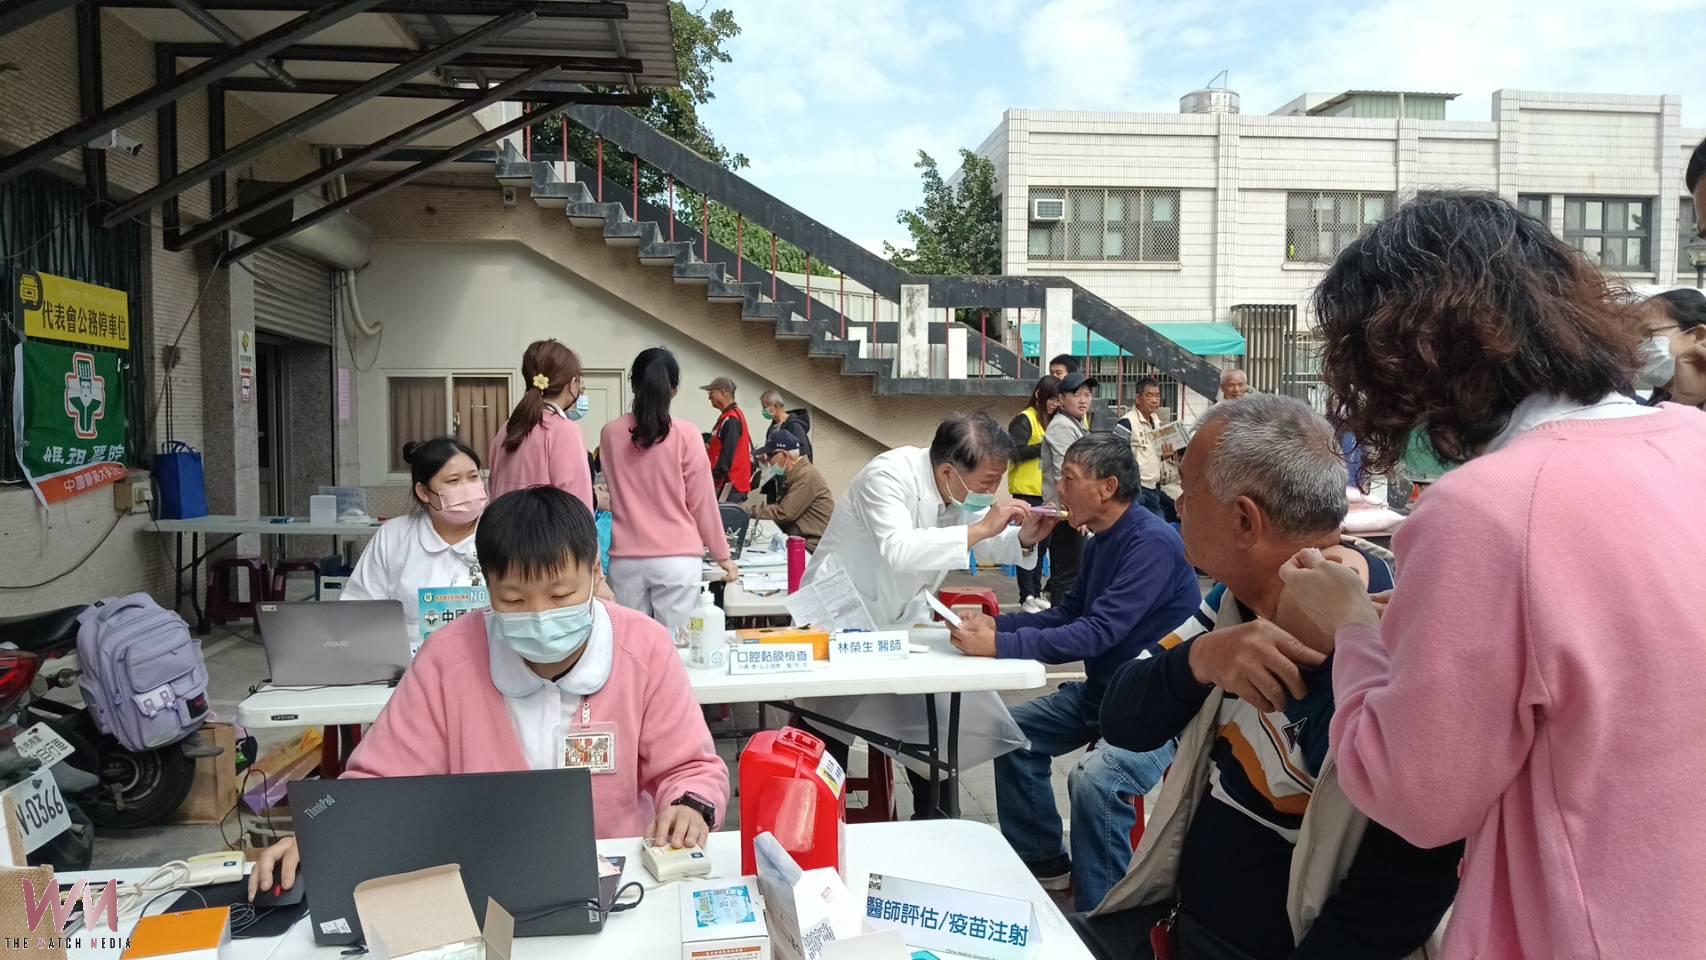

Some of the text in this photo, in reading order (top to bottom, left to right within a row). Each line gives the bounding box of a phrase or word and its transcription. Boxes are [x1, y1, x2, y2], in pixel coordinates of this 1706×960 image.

[42, 300, 127, 341] 代表會公務停車位
[737, 650, 808, 663] 口腔黏膜檢查
[838, 639, 902, 654] 林榮生 醫師
[303, 793, 336, 819] ThinkPad
[866, 895, 1029, 947] 醫師評估/疫苗注射
